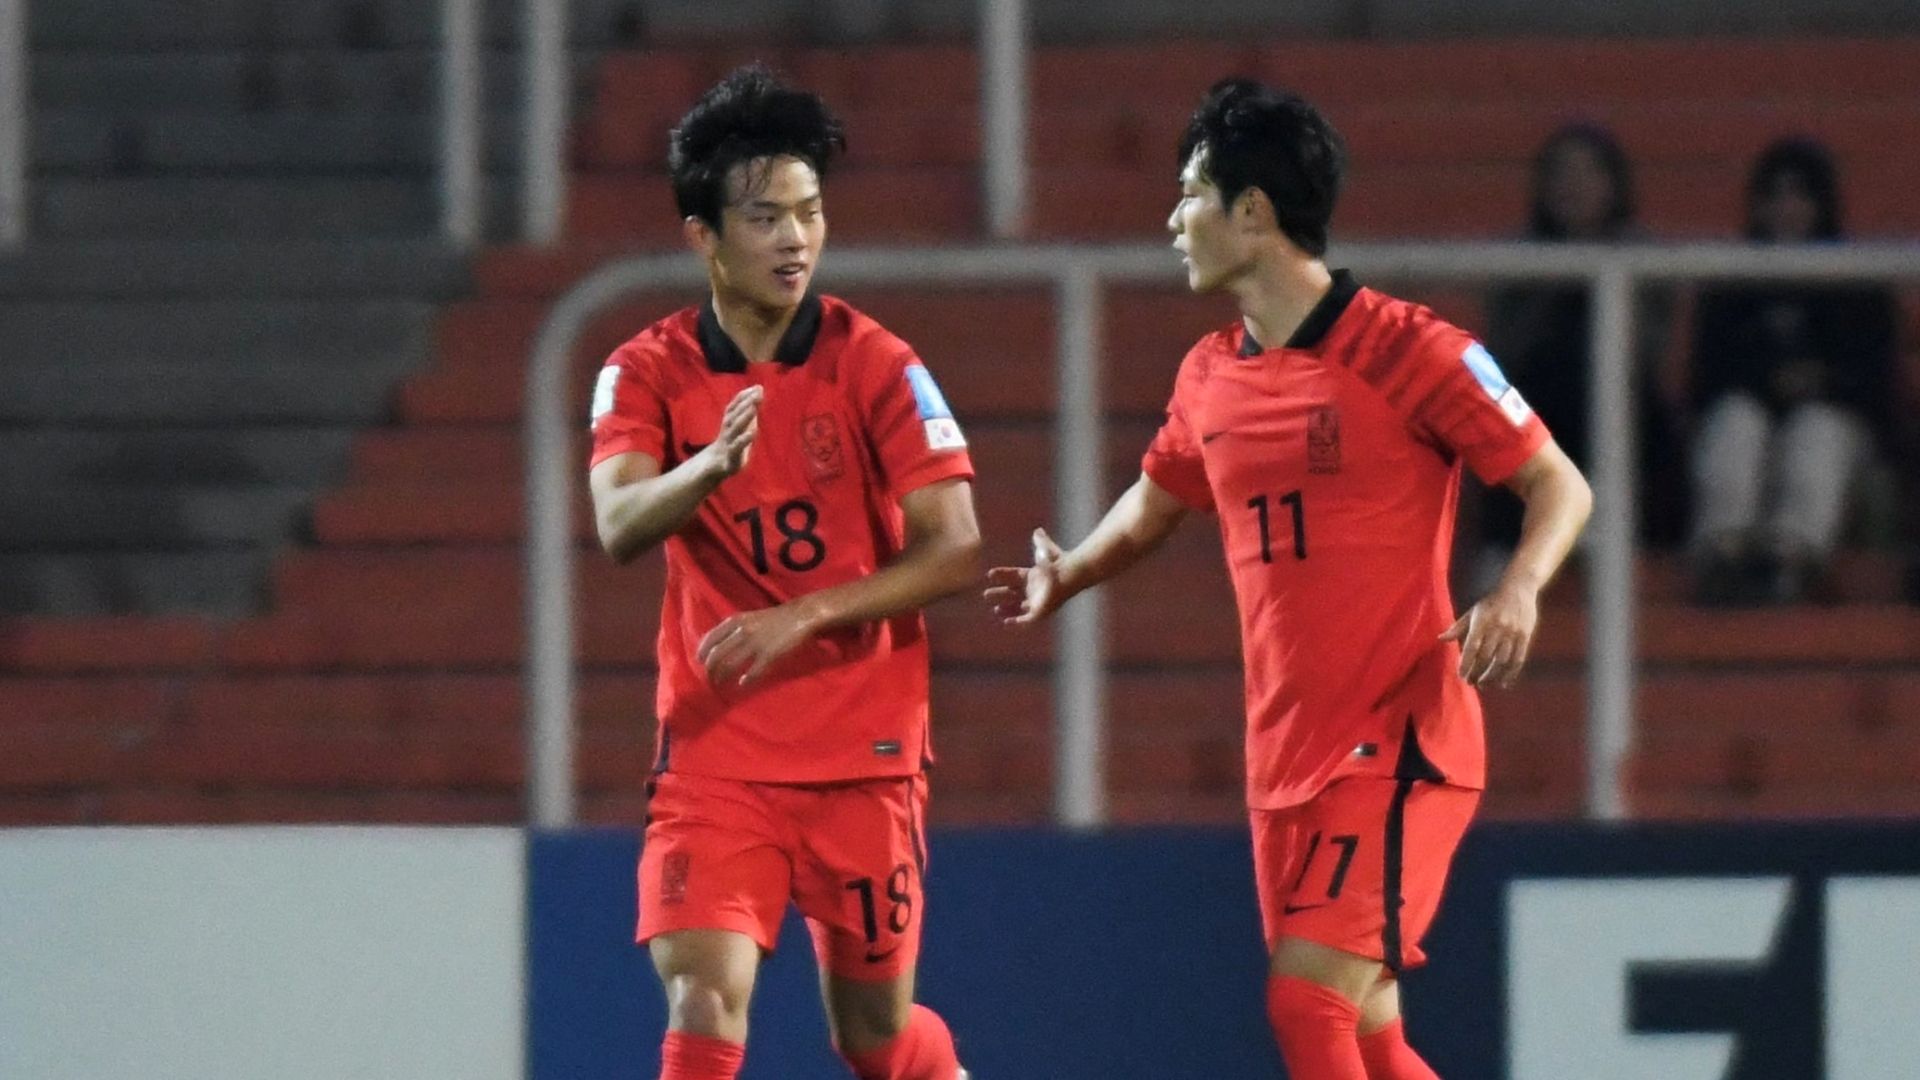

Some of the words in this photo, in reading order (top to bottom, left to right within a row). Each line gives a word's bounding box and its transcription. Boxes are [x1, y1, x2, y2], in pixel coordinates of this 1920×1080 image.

[734, 498, 826, 575] 18
[1247, 490, 1307, 565] 11
[845, 863, 913, 943] 18
